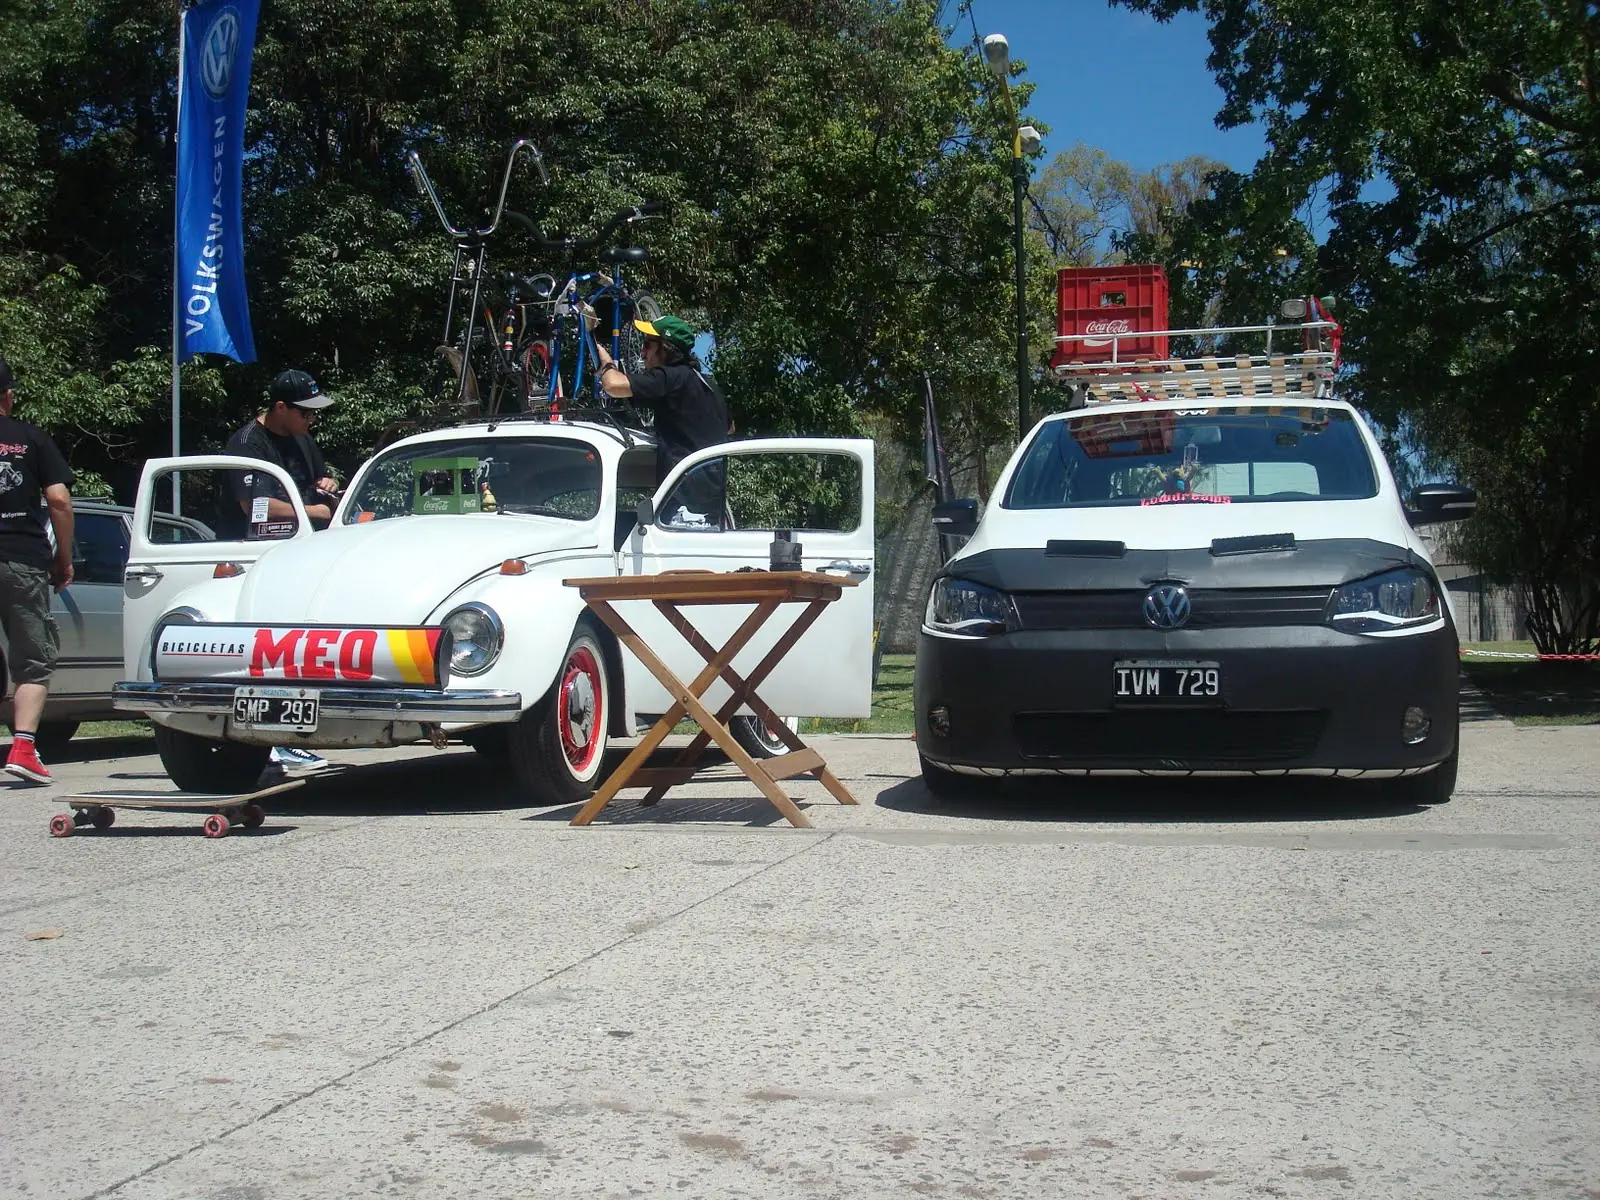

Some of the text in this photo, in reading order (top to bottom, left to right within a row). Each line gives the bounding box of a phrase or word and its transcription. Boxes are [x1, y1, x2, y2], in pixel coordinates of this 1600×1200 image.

[185, 115, 226, 339] VOLKSWAGEN
[1086, 319, 1130, 334] Coca-Cola
[162, 629, 379, 681] BICICLETAS MEO
[1117, 669, 1219, 695] IVM 729
[236, 699, 316, 724] SMP 293
